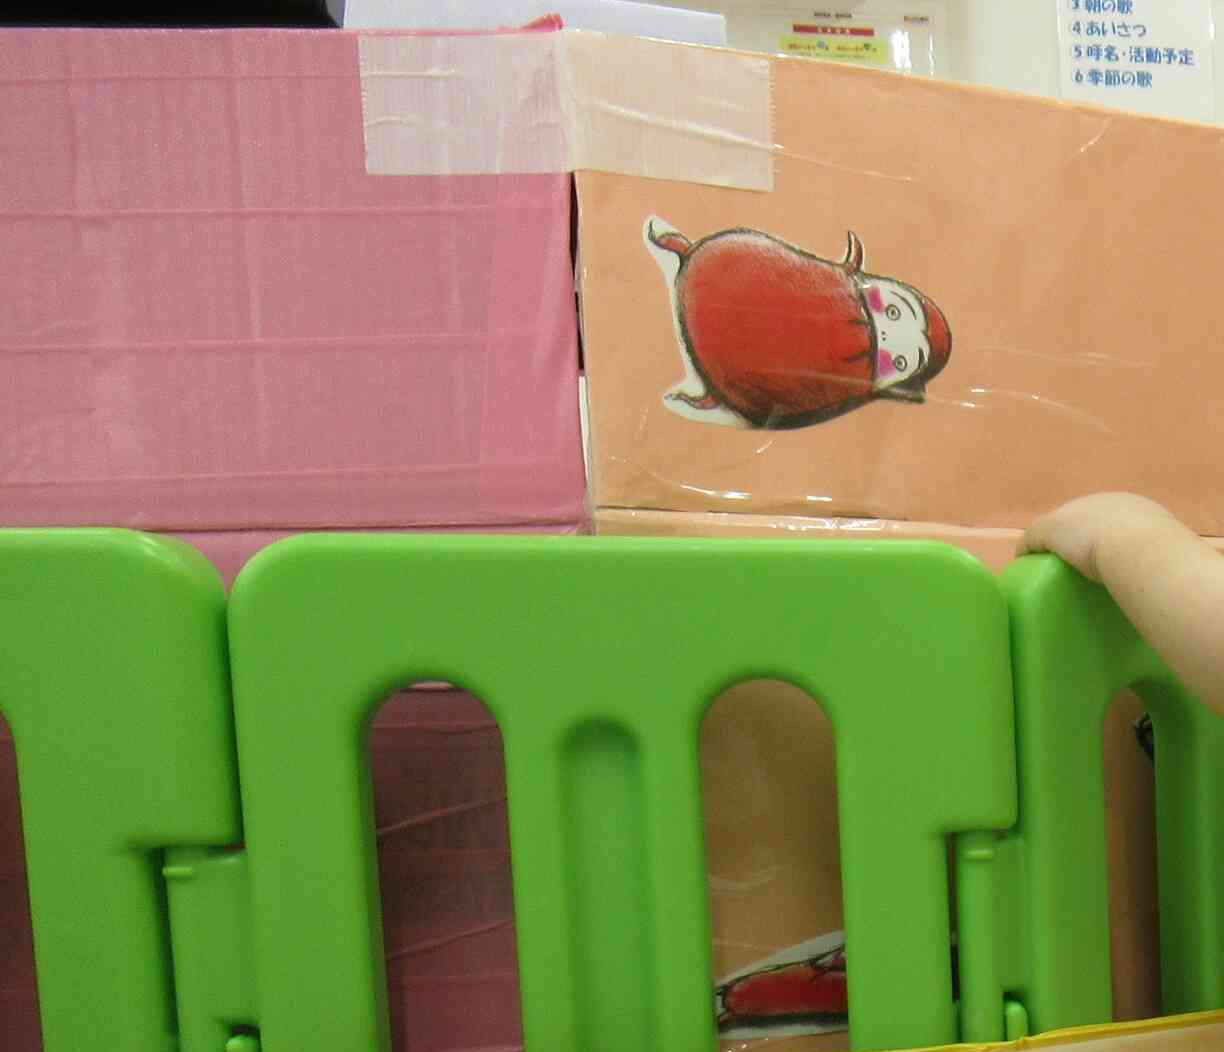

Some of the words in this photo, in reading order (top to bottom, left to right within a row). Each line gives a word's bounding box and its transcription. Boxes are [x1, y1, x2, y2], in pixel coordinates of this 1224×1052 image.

[1072, 21, 1081, 35] 4
[1086, 20, 1147, 37] あいさつ
[1074, 45, 1082, 58] 5
[1075, 69, 1083, 83] 6
[1088, 69, 1152, 88] 季節の歌
